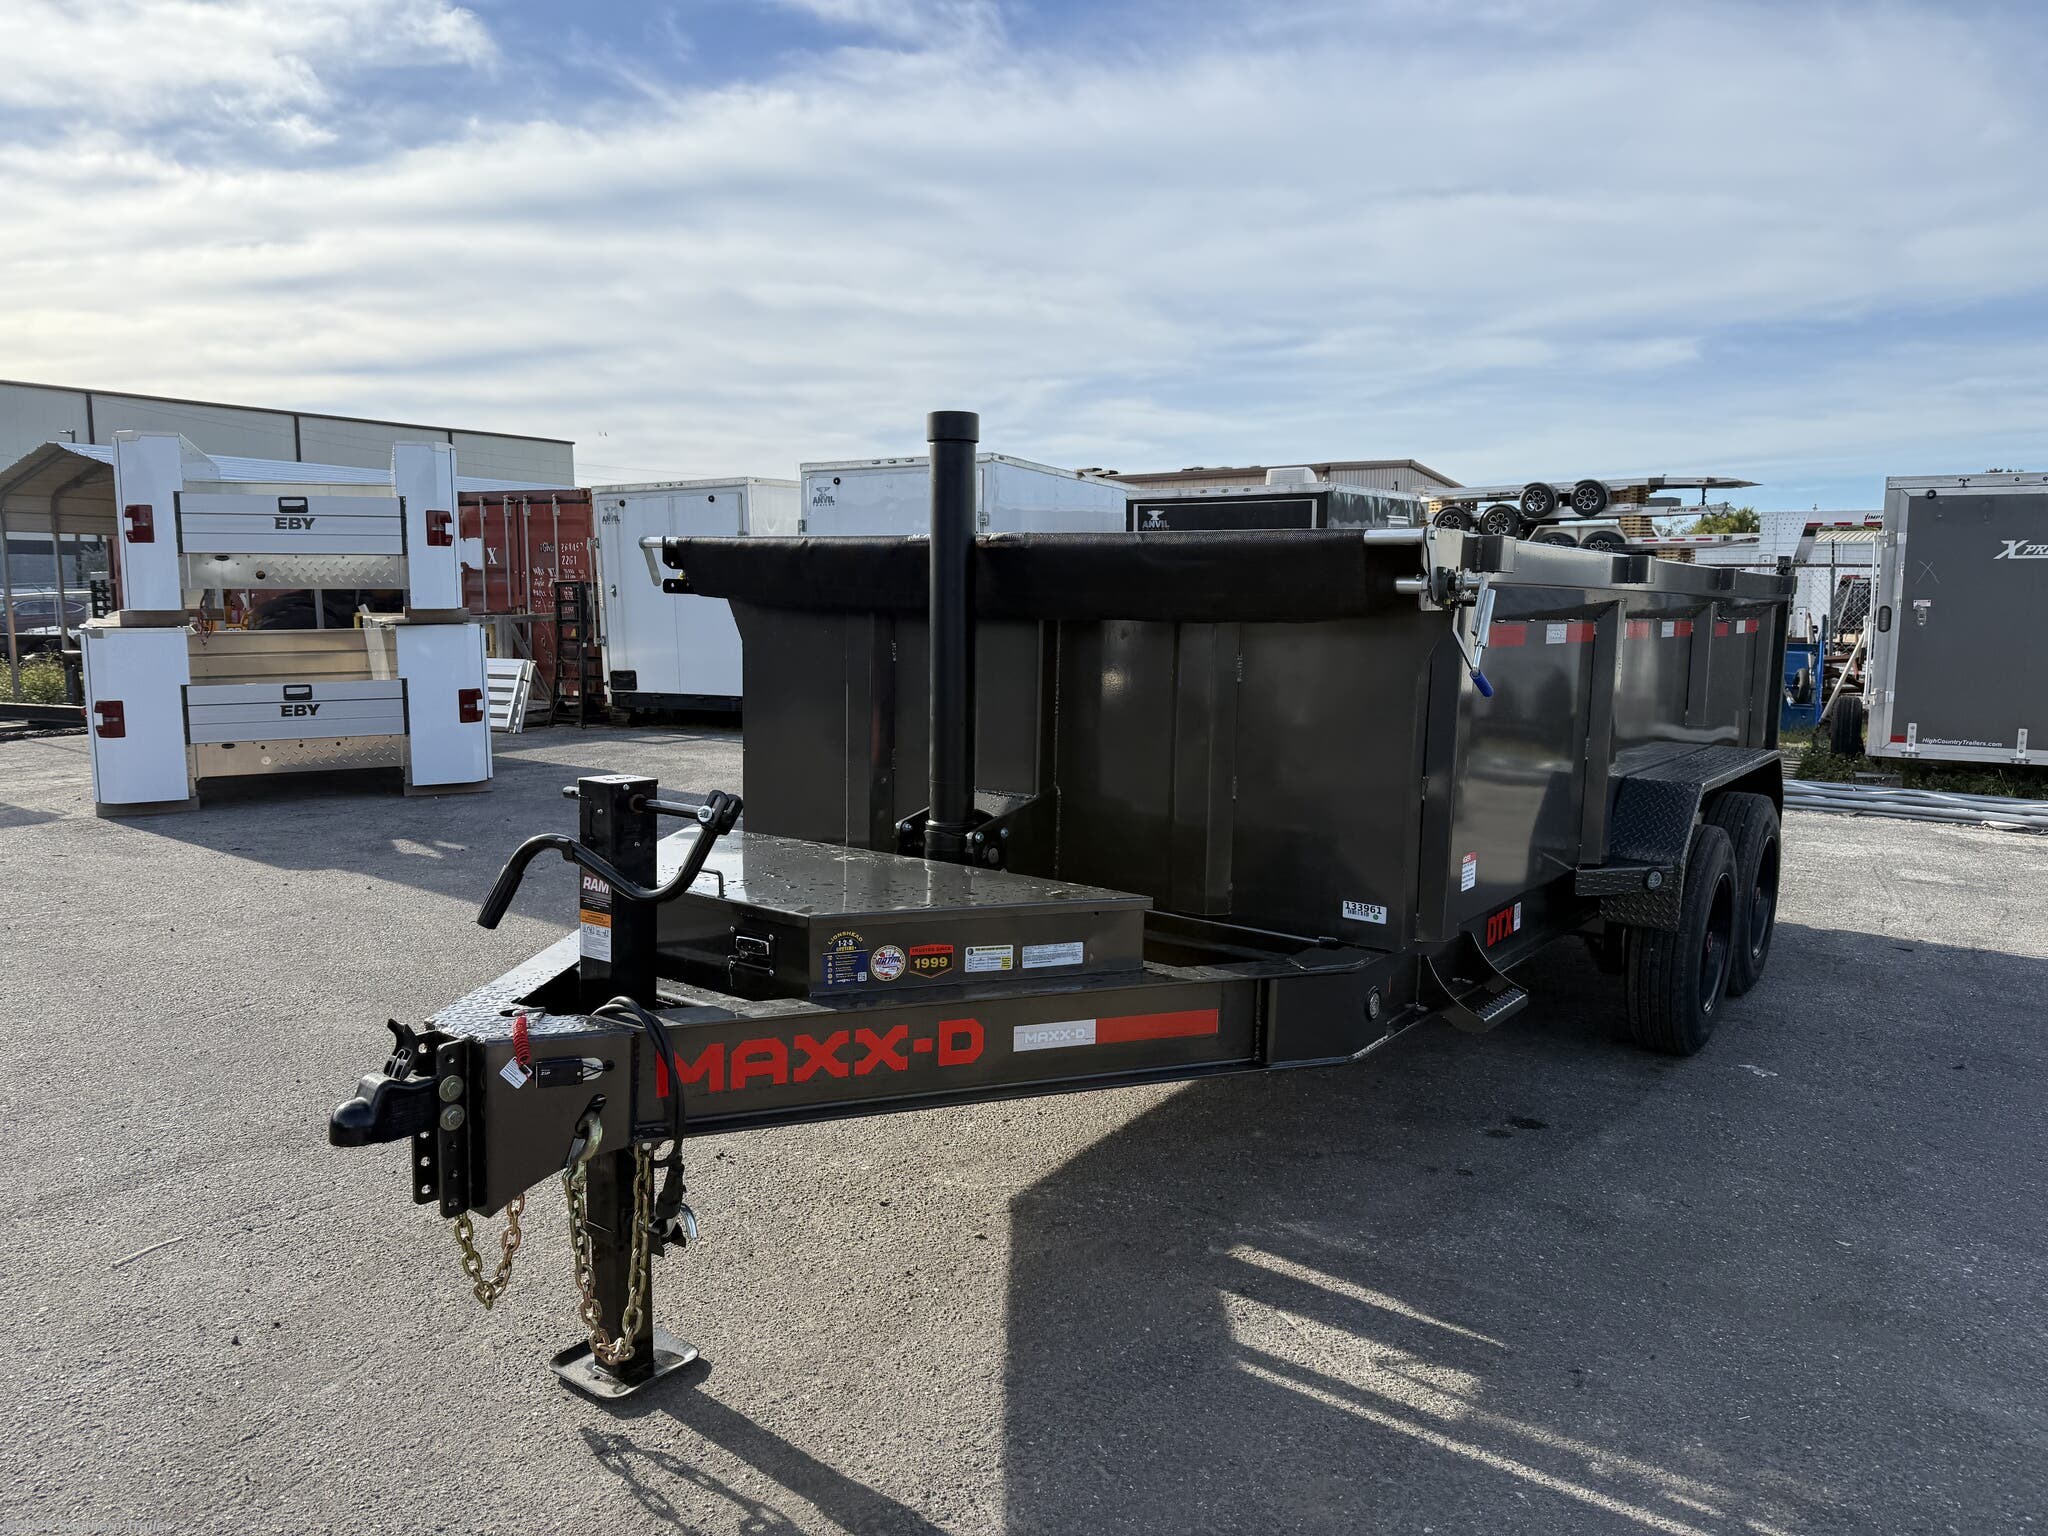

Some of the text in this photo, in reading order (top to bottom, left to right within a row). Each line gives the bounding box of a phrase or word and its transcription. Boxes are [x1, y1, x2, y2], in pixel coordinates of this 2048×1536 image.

[813, 496, 834, 504] ANVIL
[273, 516, 316, 530] EBY
[1142, 519, 1170, 529] ANVIL
[487, 547, 498, 565] X
[280, 704, 320, 717] EBY
[1922, 737, 2003, 748] HighCountryTrailers.com
[583, 876, 609, 894] RAM
[1345, 901, 1382, 914] 133961
[1487, 905, 1514, 947] DTX
[914, 956, 948, 969] 1999
[1024, 1028, 1085, 1044] MAXX-D
[655, 1018, 985, 1098] MAXX-D
